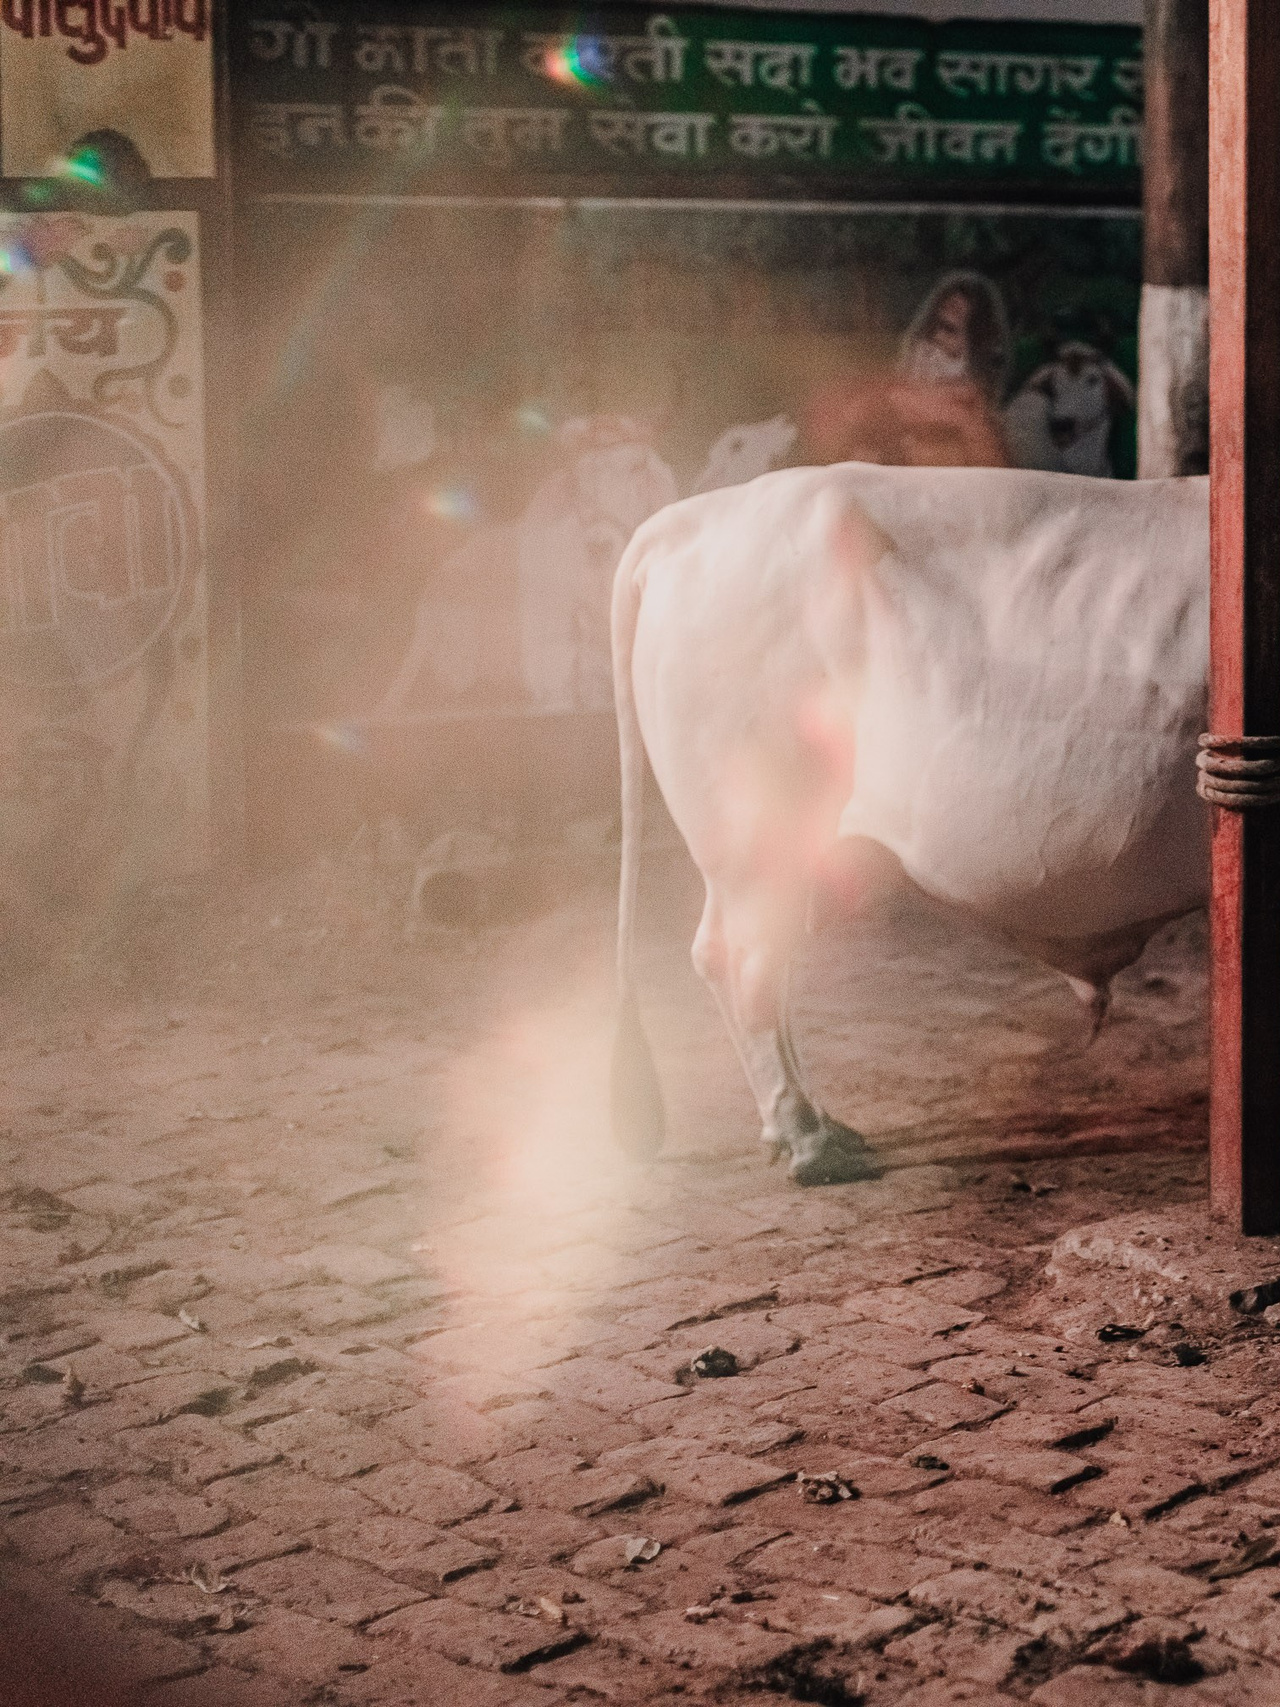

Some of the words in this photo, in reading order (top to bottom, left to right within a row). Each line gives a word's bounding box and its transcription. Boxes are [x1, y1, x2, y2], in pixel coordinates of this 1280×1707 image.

[704, 38, 820, 97] सदा
[832, 43, 924, 93] भव
[936, 50, 1102, 101] सागर
[727, 98, 840, 160] करो
[858, 101, 1023, 165] जीवन
